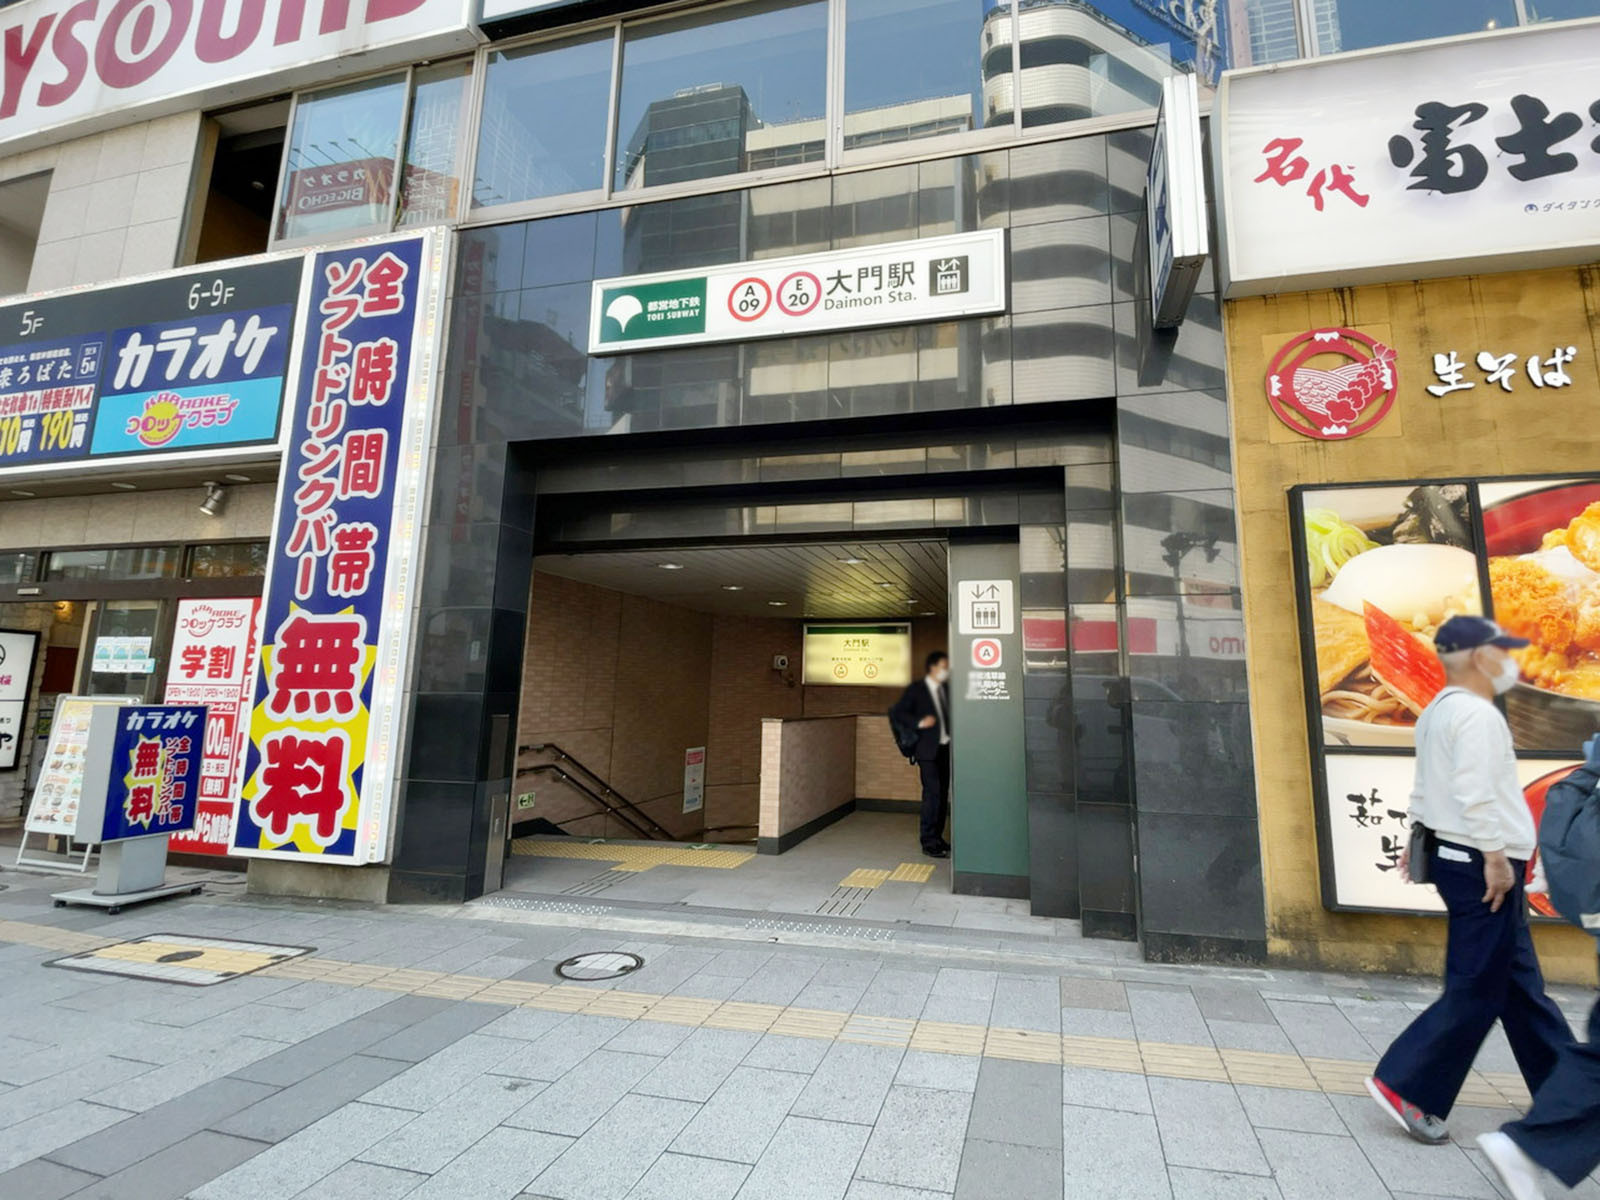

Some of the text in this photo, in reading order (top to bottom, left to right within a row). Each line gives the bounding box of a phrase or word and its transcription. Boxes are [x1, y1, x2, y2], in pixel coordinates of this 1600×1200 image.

[1387, 93, 1600, 195] 富士
[1254, 137, 1370, 212] 名代
[188, 279, 235, 309] 6-9F
[745, 285, 755, 296] A
[796, 279, 803, 291] E
[826, 261, 915, 296] 大門駅
[739, 298, 760, 312] 09
[788, 292, 809, 307] 20
[824, 290, 917, 311] Daimon Sta.
[19, 311, 43, 336] 5F
[113, 314, 278, 390] カラオケ
[1426, 345, 1577, 398] 生そば
[285, 257, 367, 600] ソフトドリンクバー
[327, 251, 408, 597] 全時間帯
[180, 645, 236, 679] 学割
[983, 648, 991, 657] A
[126, 711, 198, 730] カラオケ
[249, 611, 367, 845] 無料
[126, 740, 162, 824] 無料
